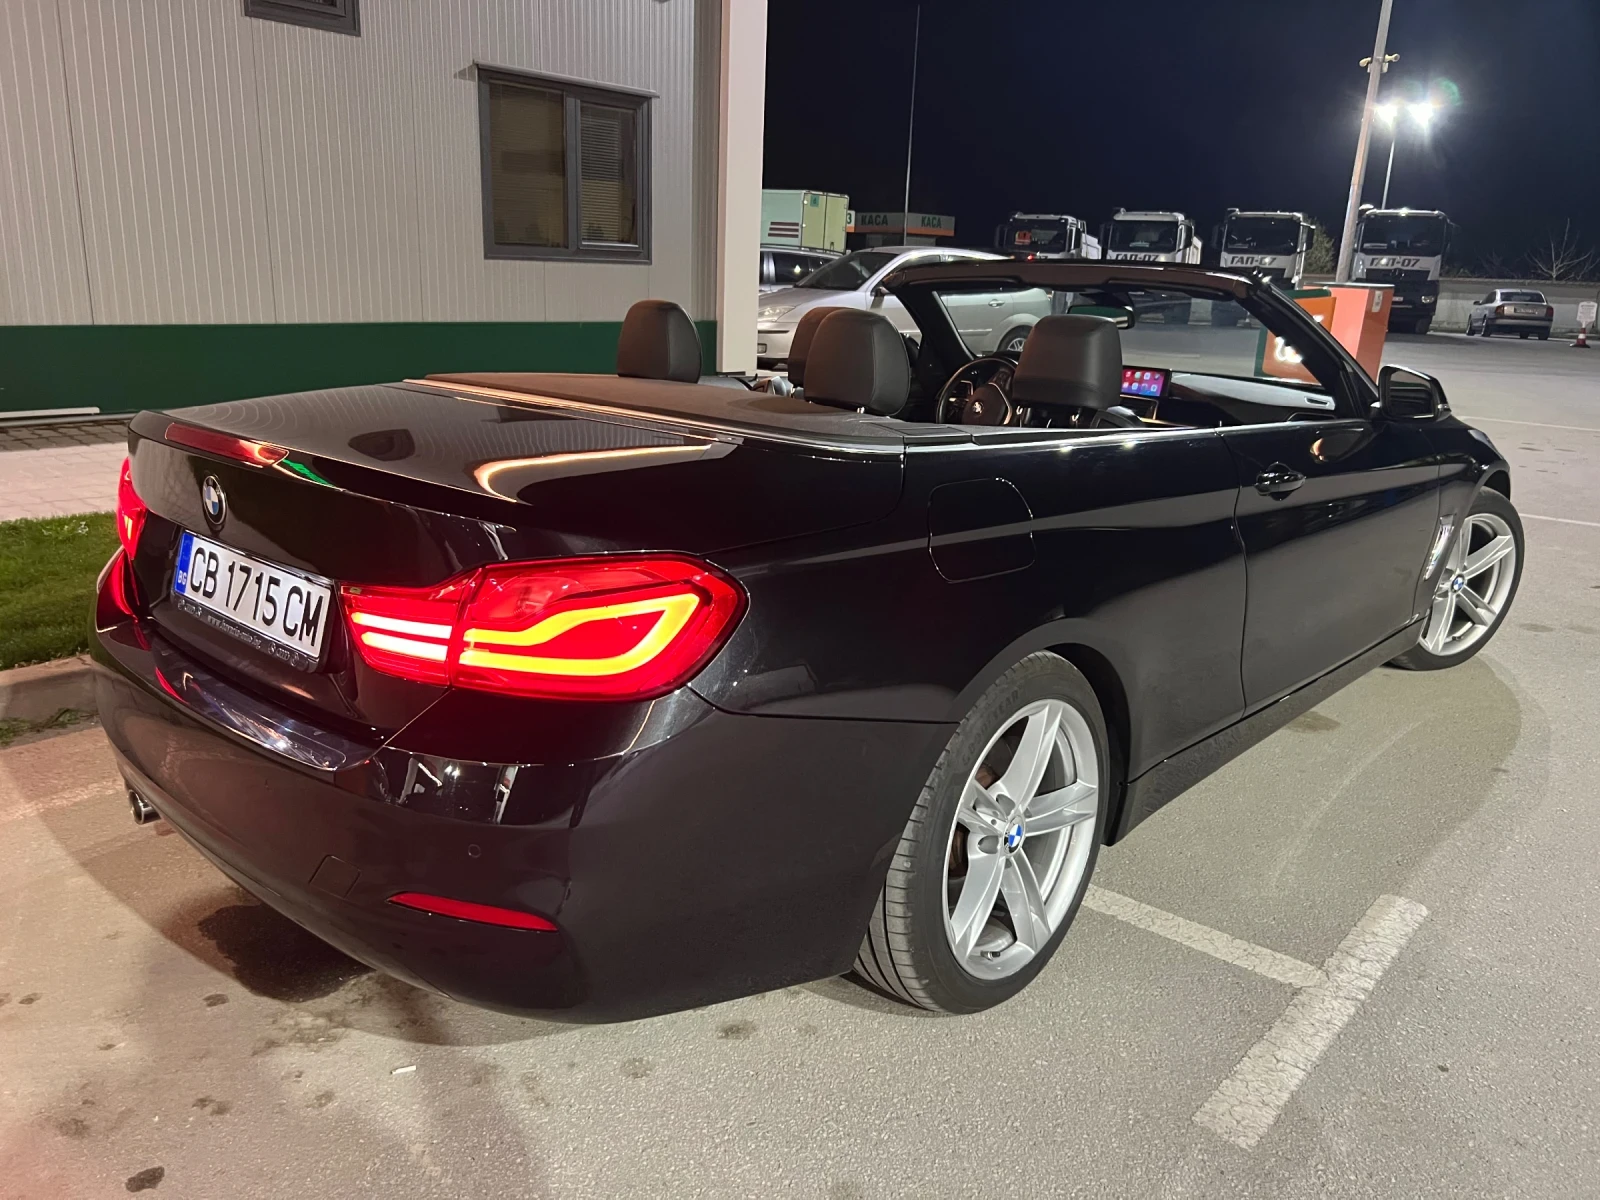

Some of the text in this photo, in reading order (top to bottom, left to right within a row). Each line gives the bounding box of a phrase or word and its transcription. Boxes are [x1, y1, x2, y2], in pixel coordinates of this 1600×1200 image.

[177, 570, 188, 586] BG
[190, 547, 324, 647] CB 1715 CM
